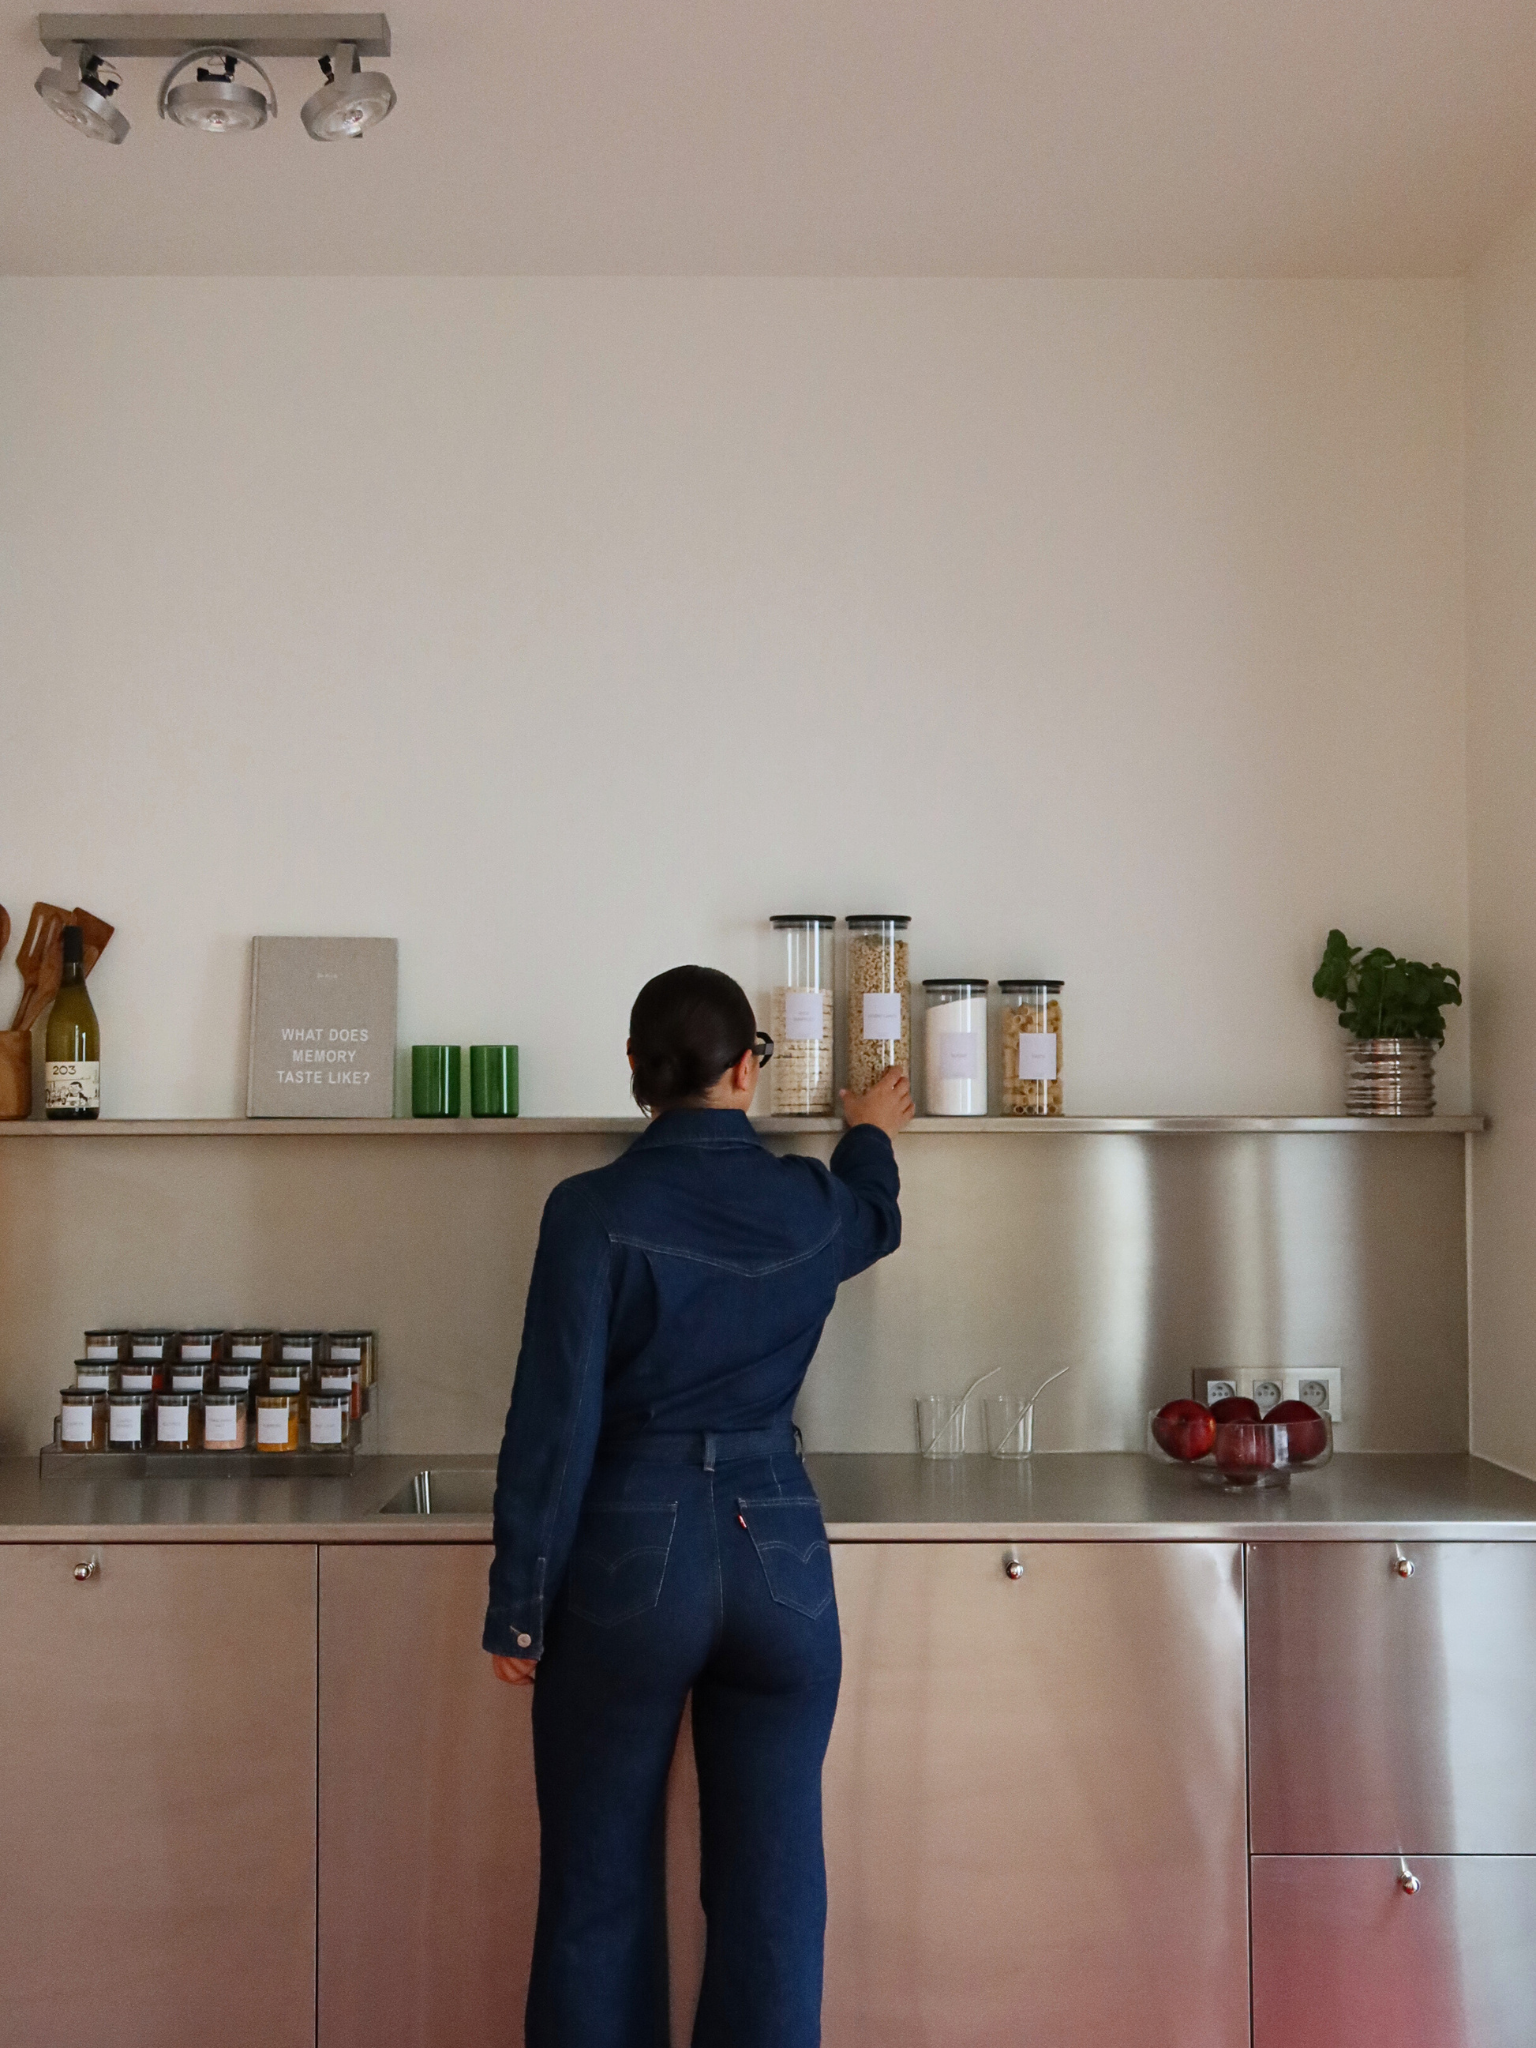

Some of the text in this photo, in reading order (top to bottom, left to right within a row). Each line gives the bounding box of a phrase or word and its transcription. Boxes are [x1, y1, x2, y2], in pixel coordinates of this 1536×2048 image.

[281, 1028, 369, 1042] WHAT DOES
[292, 1049, 356, 1063] MEMORY
[52, 1065, 77, 1076] 203
[277, 1070, 370, 1084] TASTE LIKE?
